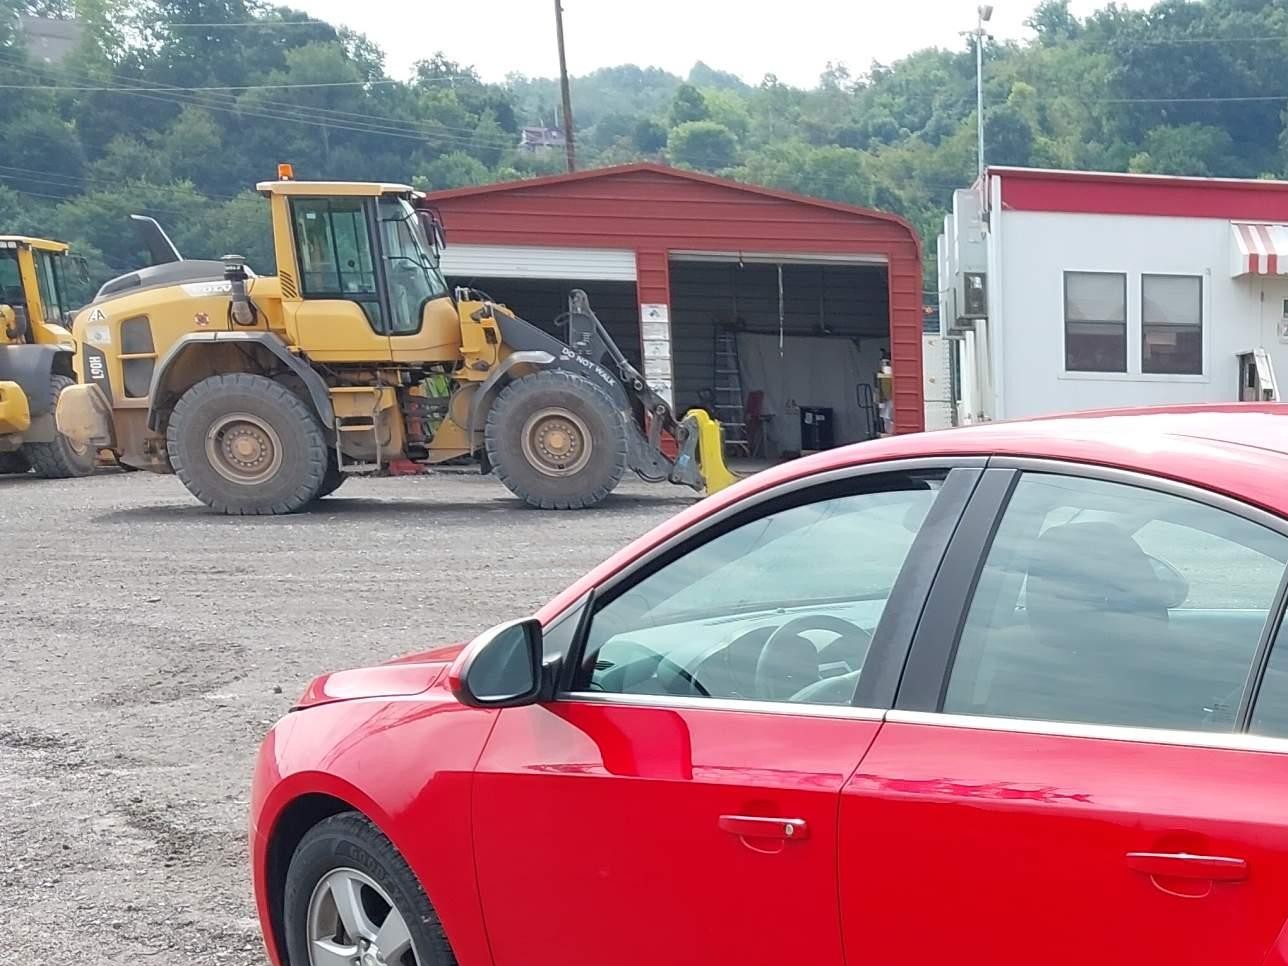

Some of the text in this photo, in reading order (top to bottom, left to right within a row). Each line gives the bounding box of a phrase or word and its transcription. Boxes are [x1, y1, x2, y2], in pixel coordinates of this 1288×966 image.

[89, 356, 105, 379] L90H
[562, 347, 576, 359] DO
[576, 356, 595, 369] NOT
[595, 365, 617, 387] WALK
